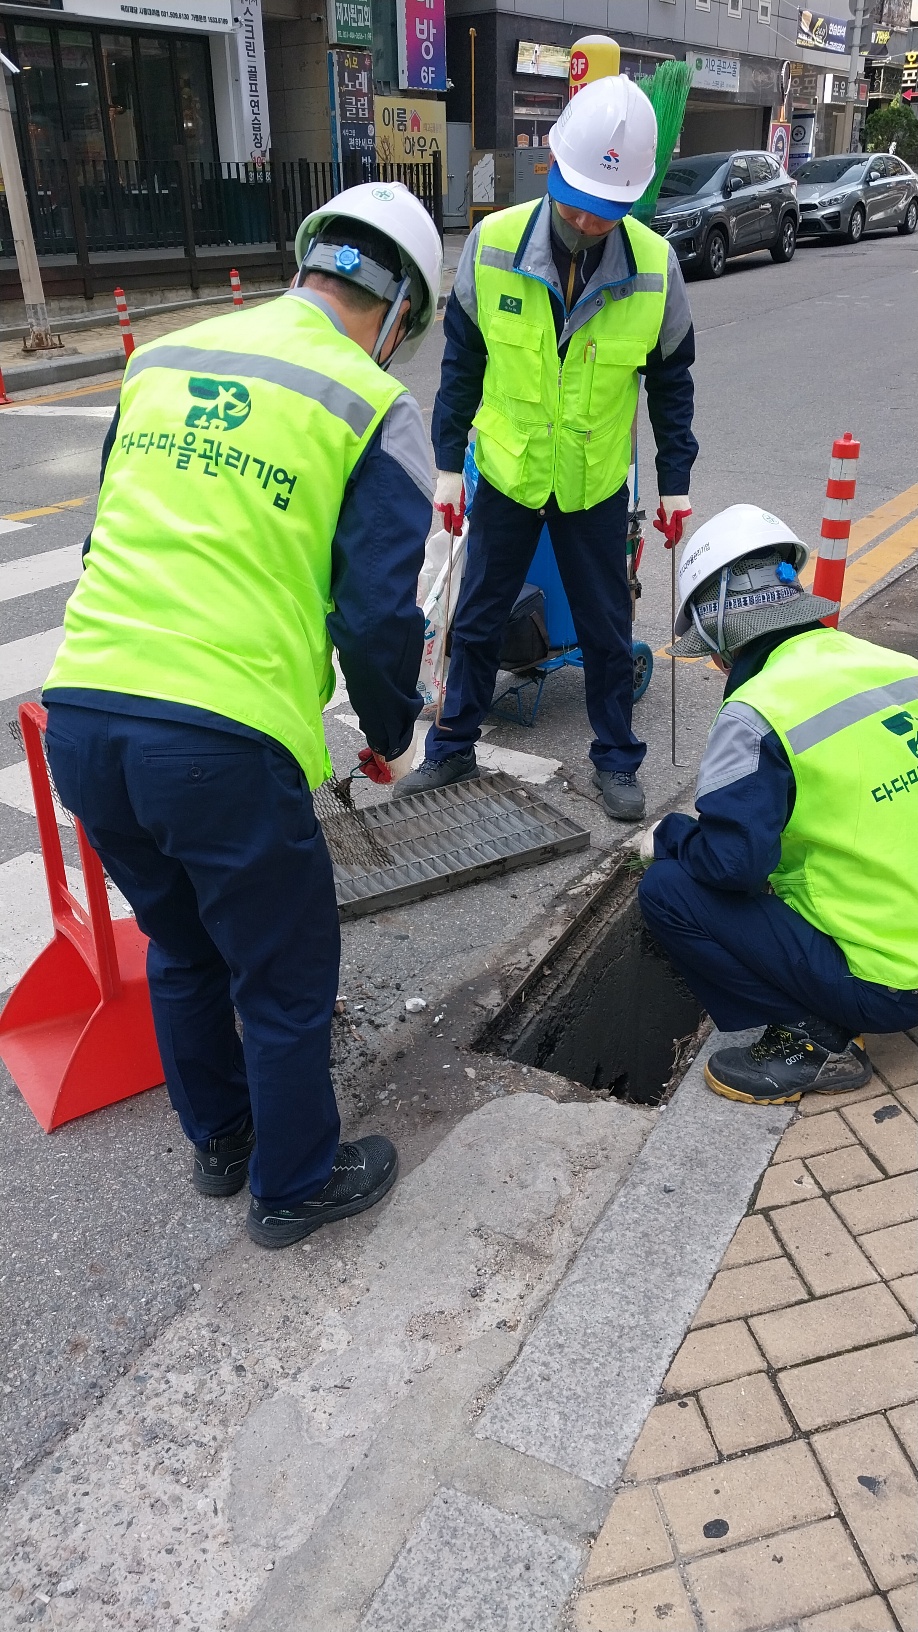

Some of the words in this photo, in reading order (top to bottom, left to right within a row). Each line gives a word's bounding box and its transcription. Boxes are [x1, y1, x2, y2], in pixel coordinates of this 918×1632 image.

[336, 2, 371, 28] 제자된교회
[420, 66, 436, 85] 6F
[571, 58, 586, 75] 3F
[344, 69, 368, 93] 노래
[345, 96, 369, 118] 클럽
[382, 107, 408, 132] 이룸
[404, 136, 441, 159] 하우스
[121, 431, 298, 511] 다다마을관리기업
